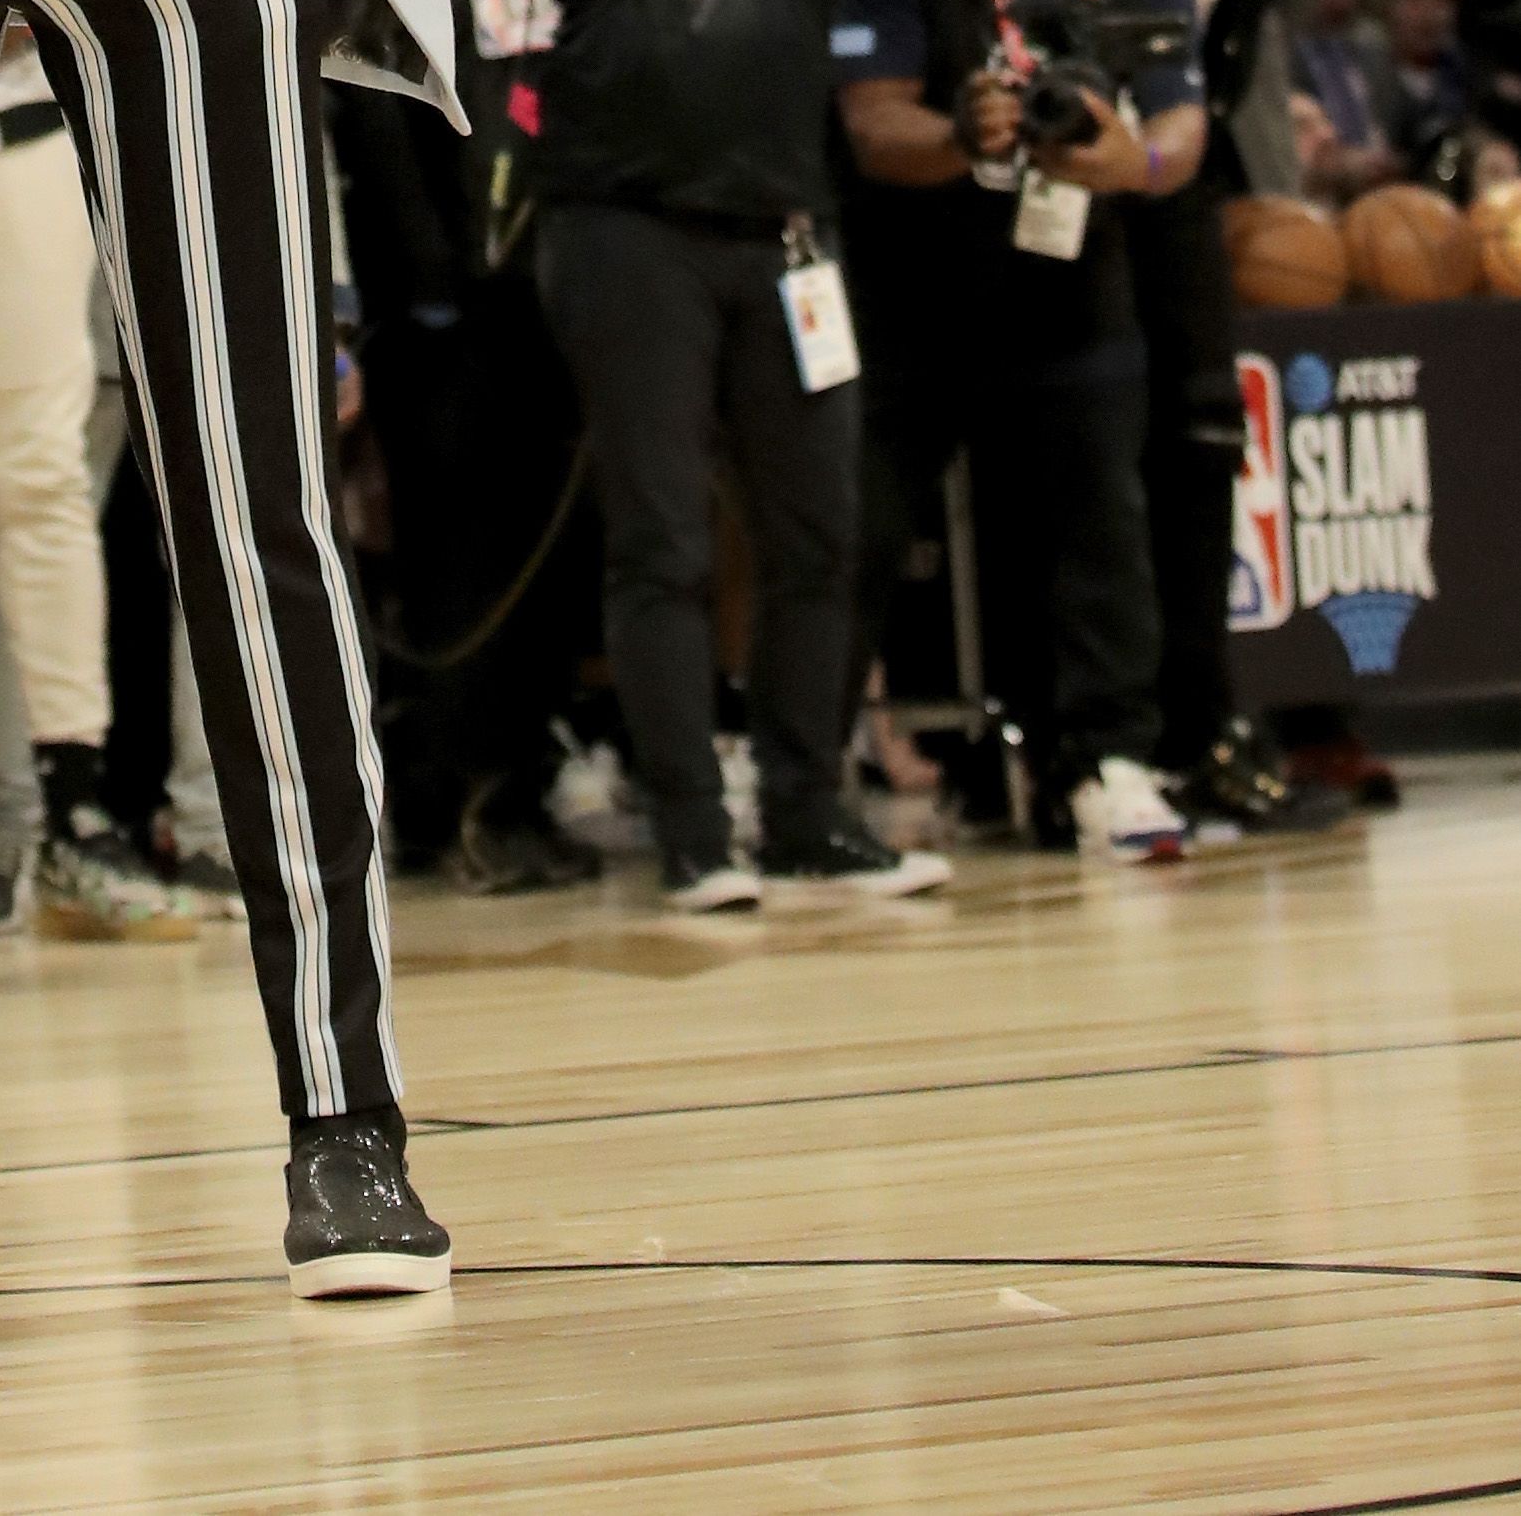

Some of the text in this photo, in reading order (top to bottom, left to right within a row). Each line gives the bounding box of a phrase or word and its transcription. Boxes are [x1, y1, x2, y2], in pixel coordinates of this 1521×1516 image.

[1336, 356, 1422, 404] AT&T
[1289, 408, 1434, 521] SLAM
[1294, 514, 1439, 611] DUNK
